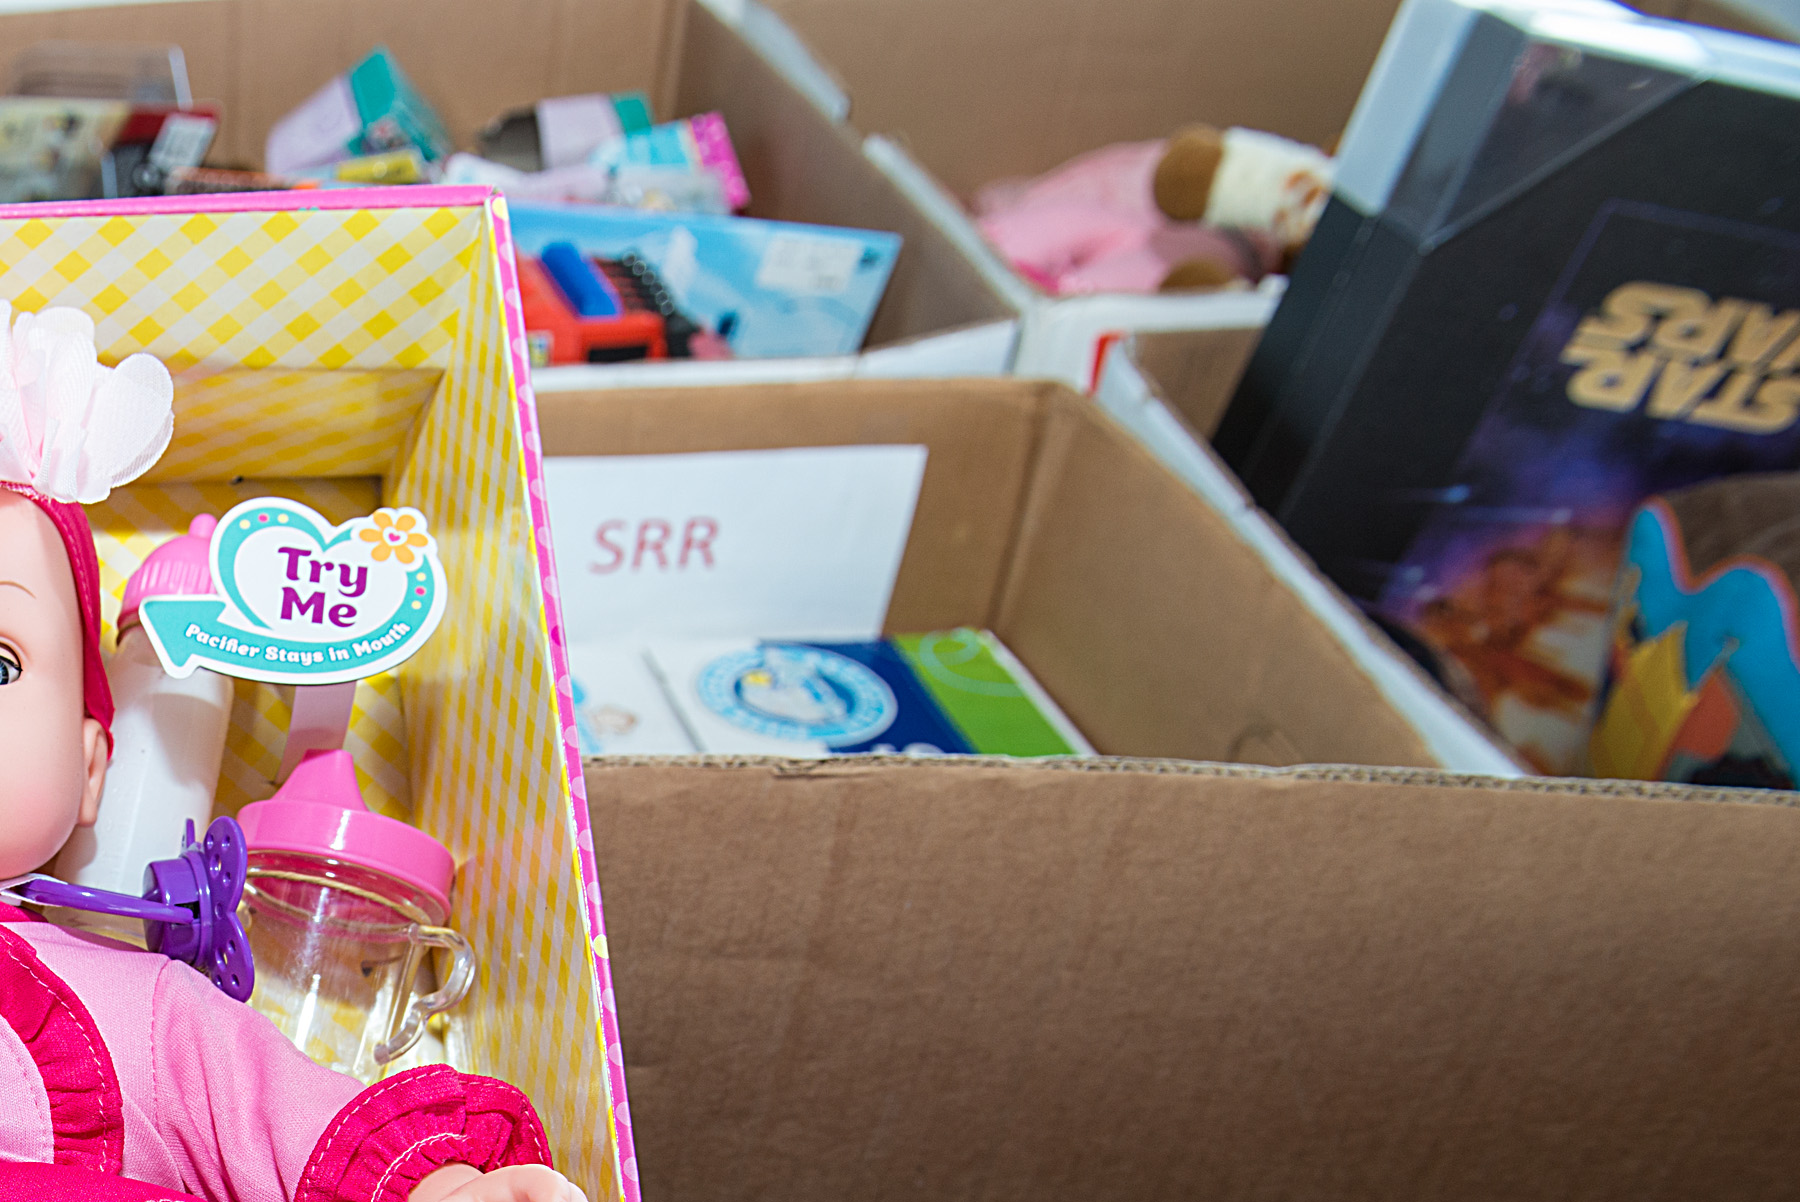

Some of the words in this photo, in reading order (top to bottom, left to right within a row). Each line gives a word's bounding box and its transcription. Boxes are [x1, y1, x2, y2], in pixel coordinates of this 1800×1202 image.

[1561, 343, 1800, 435] STAR
[587, 515, 719, 575] SRR
[277, 546, 368, 598] Try
[280, 586, 358, 628] Me
[185, 622, 260, 659] Pacifier
[265, 645, 324, 667] Stays
[329, 646, 350, 662] in
[353, 621, 411, 657] Mouth
